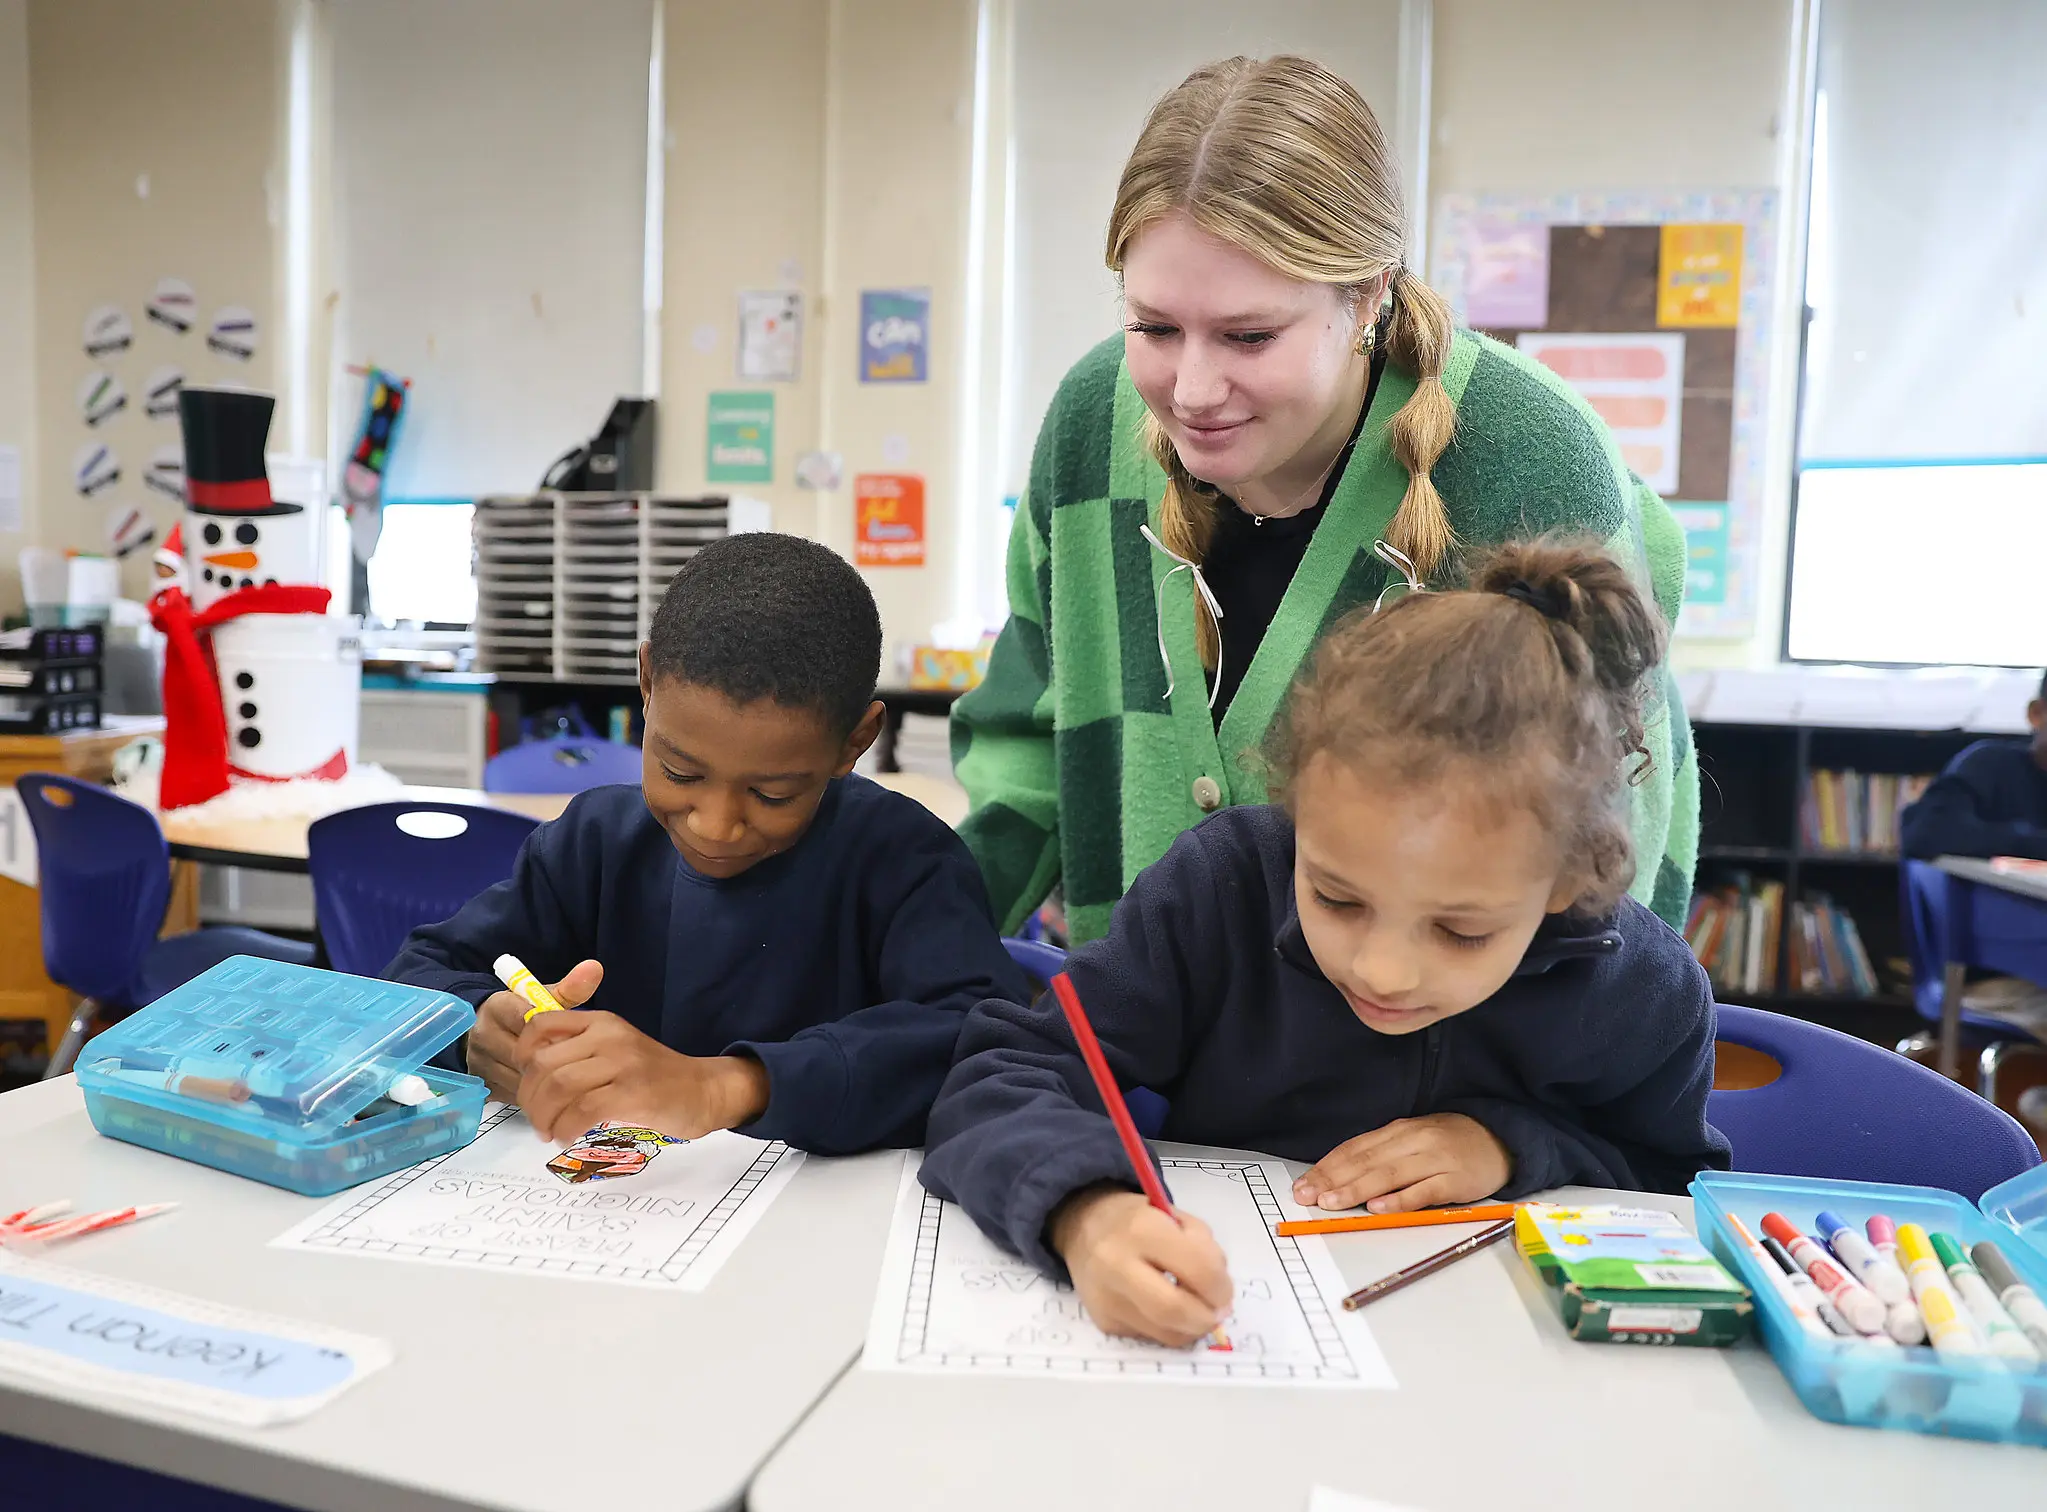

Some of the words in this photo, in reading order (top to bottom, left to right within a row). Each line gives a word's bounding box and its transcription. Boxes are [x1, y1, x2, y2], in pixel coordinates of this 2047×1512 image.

[429, 1178, 696, 1217] NICHOLAS
[408, 1221, 472, 1240] OF
[455, 1205, 637, 1234] SAINT
[481, 1231, 634, 1257] FEAST
[68, 1312, 284, 1379] Keenan
